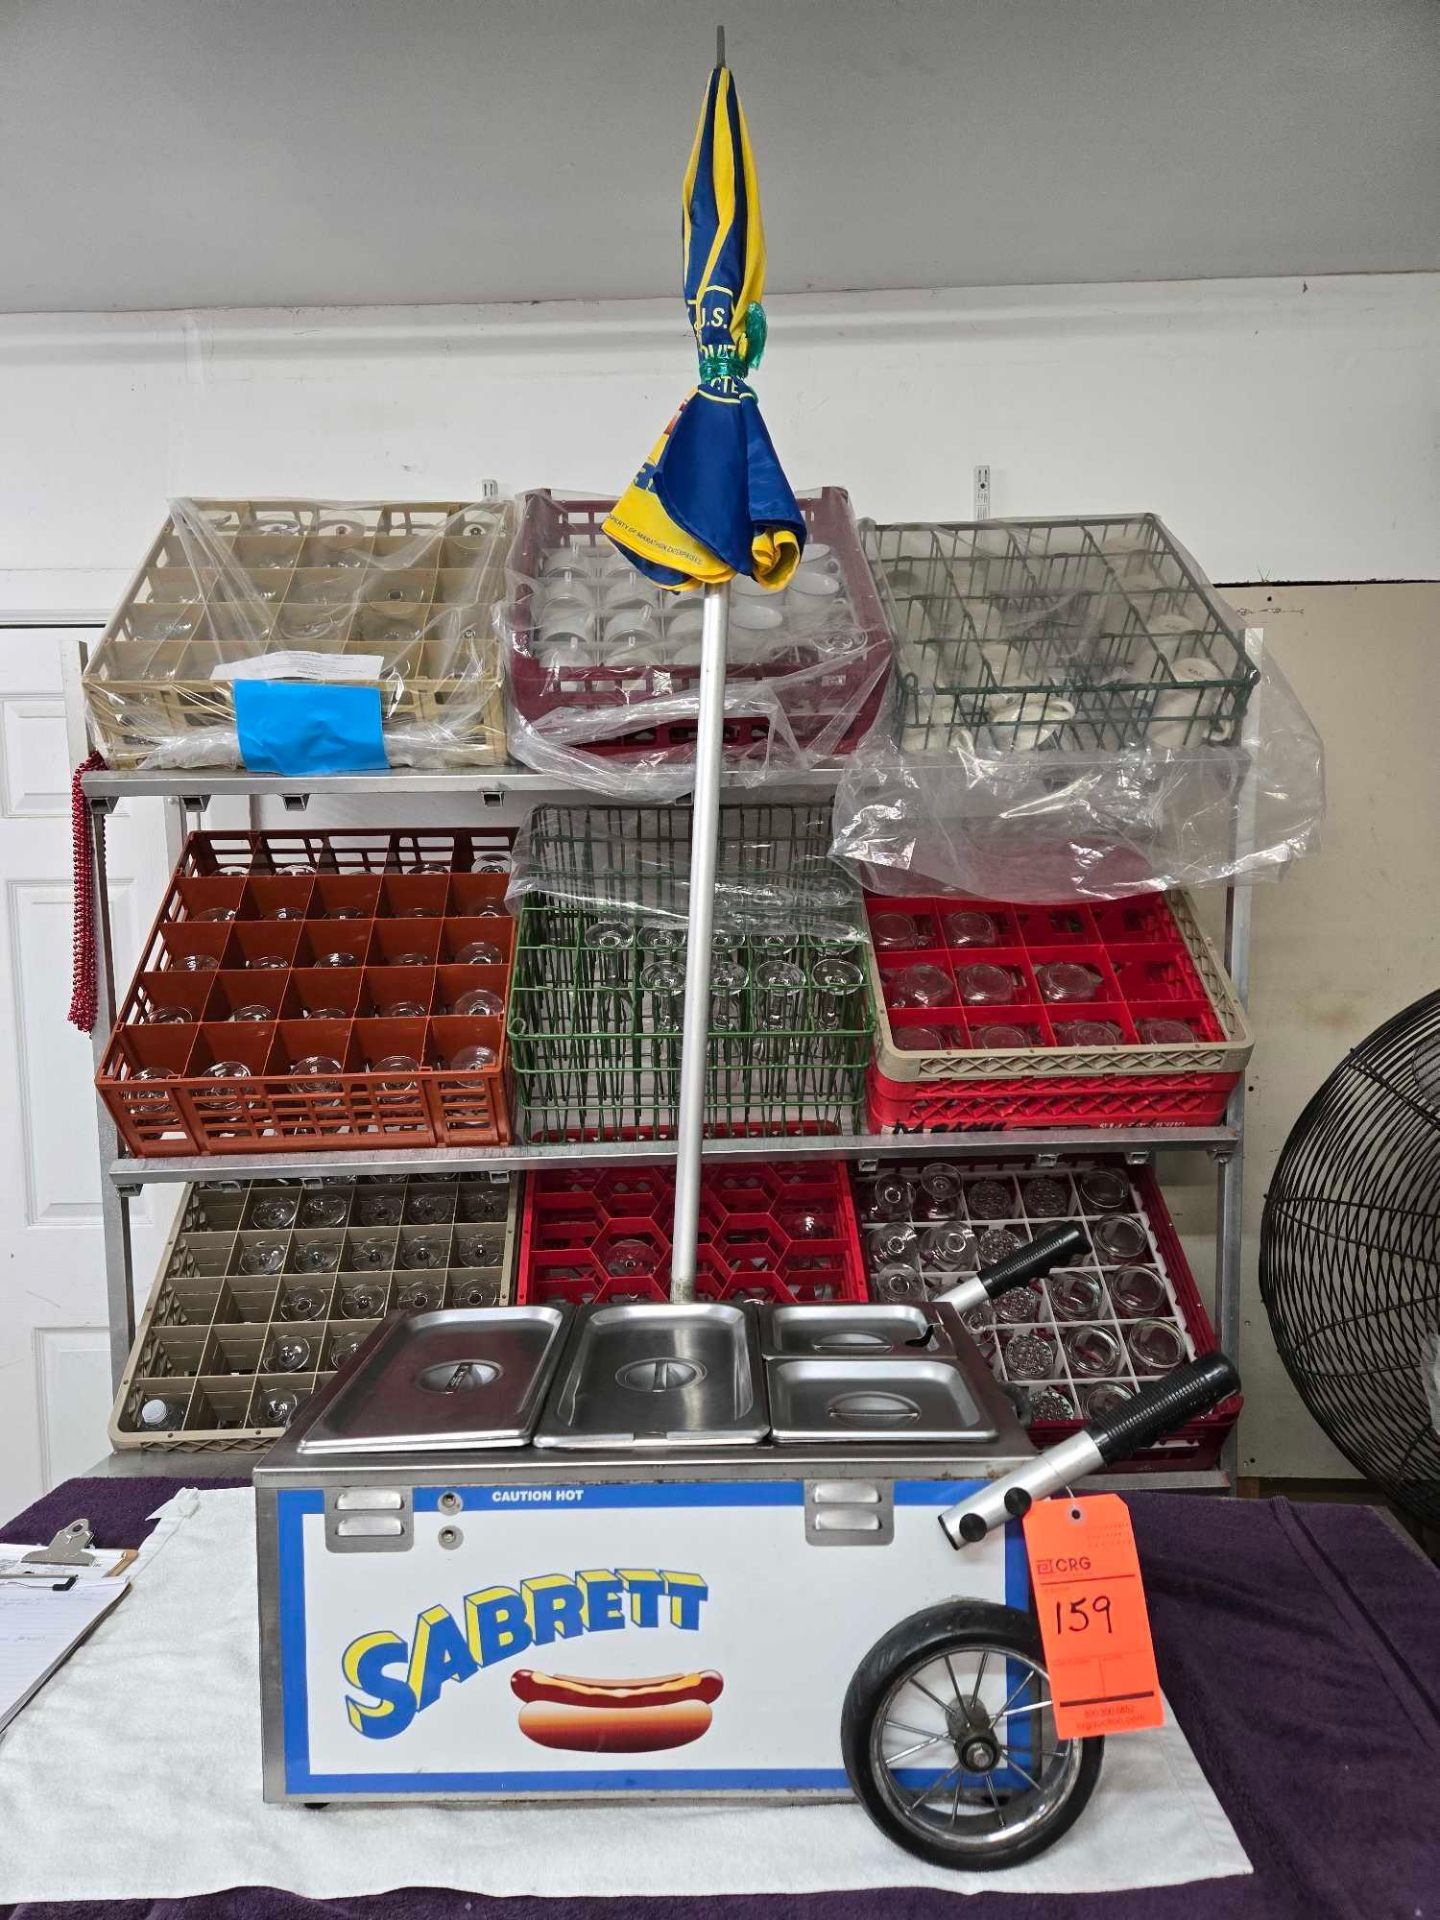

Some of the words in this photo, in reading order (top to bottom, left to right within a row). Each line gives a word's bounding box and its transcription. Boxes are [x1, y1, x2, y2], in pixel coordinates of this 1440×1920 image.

[491, 1489, 552, 1503] CAUTION
[555, 1489, 585, 1502] HOT
[1055, 1556, 1092, 1573] CRG
[1055, 1595, 1113, 1635] 159
[341, 1568, 708, 1740] SABRETT
